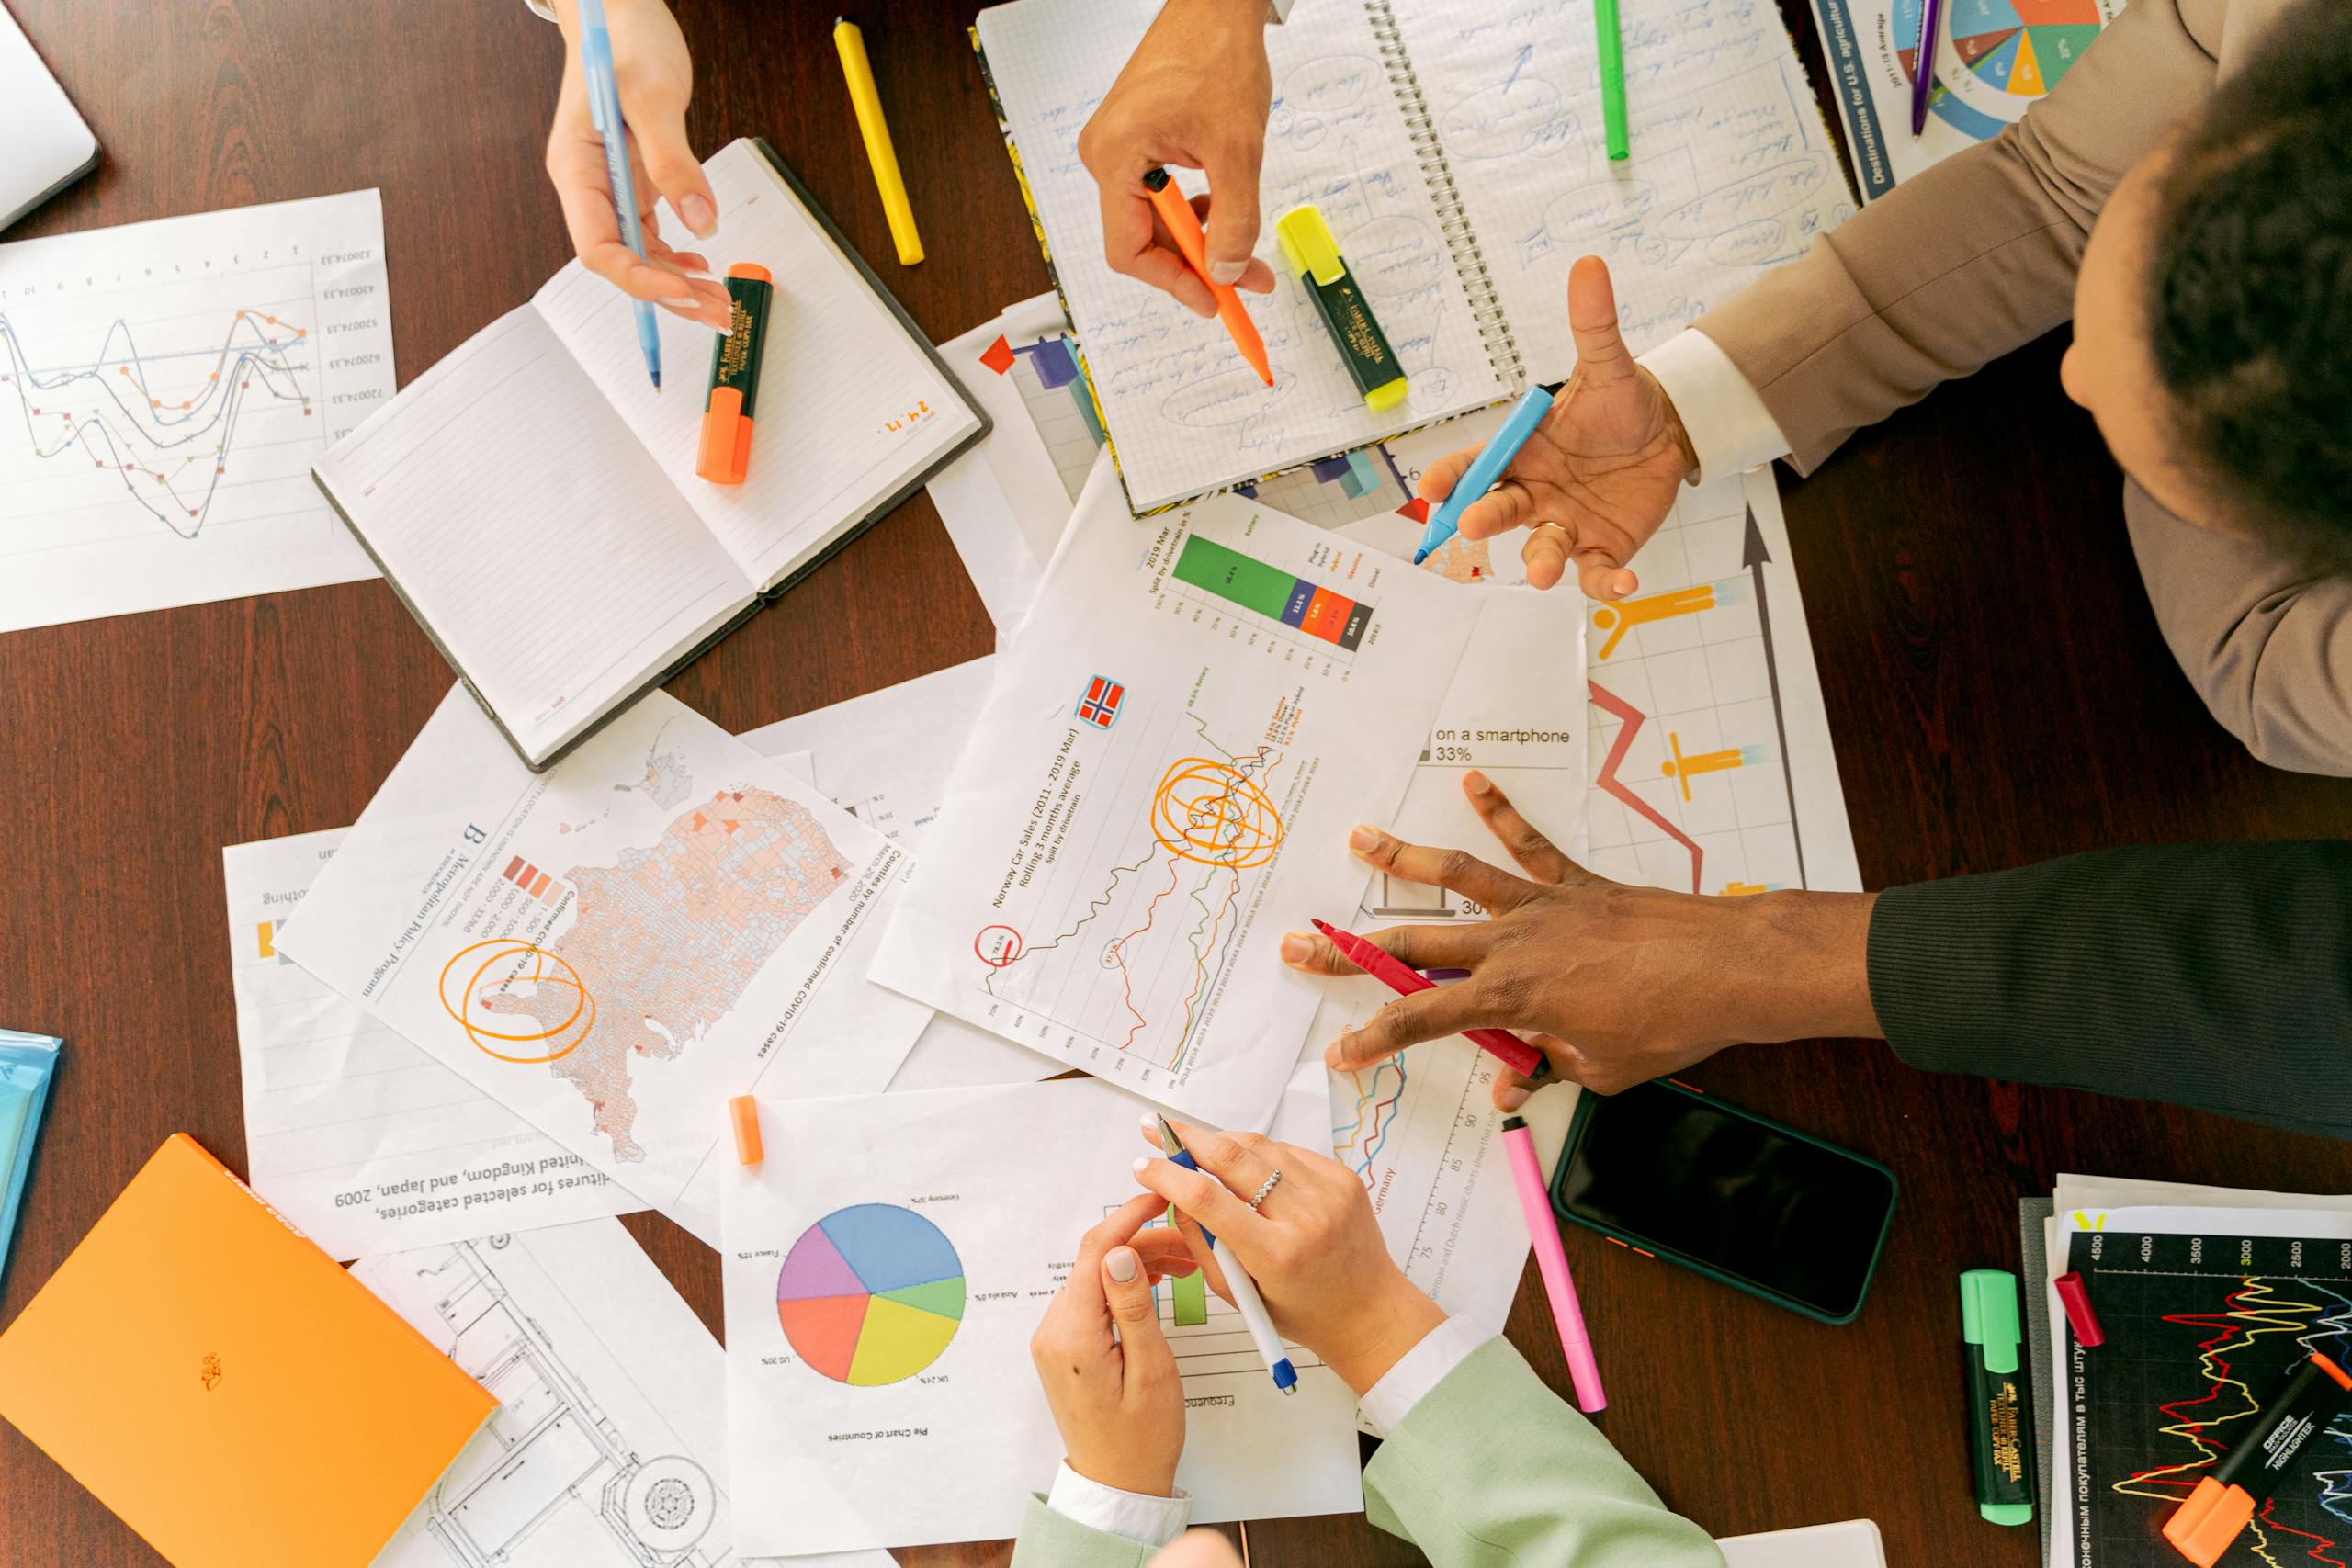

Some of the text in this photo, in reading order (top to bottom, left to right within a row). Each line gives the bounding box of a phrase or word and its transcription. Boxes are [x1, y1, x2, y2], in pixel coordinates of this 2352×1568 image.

[1872, 11, 1890, 51] Average
[1842, 60, 1859, 85] U.S.
[1851, 87, 1863, 105] for
[1856, 107, 1884, 185] Destinations
[1409, 467, 1420, 480] 6
[1179, 518, 1188, 527] in
[1146, 525, 1170, 569] 2019 Mar
[1160, 527, 1184, 565] drivetrain
[1157, 565, 1168, 577] by
[1345, 551, 1363, 580] Gasoline
[1367, 567, 1382, 588] Diesel
[1148, 576, 1162, 594] Split
[1436, 728, 1569, 744] on a smartphone
[1437, 747, 1471, 761] 33%
[511, 794, 538, 831] LOCATION
[991, 726, 1080, 908] Norway Car Sales (2011 2019 Mar)
[1017, 850, 1043, 888] Rolling
[1037, 800, 1064, 841] months
[1057, 759, 1082, 800] average
[1044, 793, 1082, 864] Split by drivetrain
[481, 835, 509, 873] UNKNOWN
[470, 870, 484, 886] ARE
[846, 841, 891, 903] March 29, 2020
[460, 886, 473, 902] NOT
[483, 876, 504, 903] 2,000
[359, 822, 487, 1002] B Metropolitan Policy Program
[516, 896, 533, 916] 500
[543, 887, 575, 932] Confirmed
[1462, 901, 1487, 914] 30
[479, 912, 501, 940] 2,000
[525, 915, 540, 934] 500
[754, 847, 901, 1062] Counties by number of confirmed COVID-19 cases
[499, 968, 519, 994] cases
[1478, 1070, 1491, 1085] 95
[1464, 1113, 1477, 1128] 90
[1477, 1127, 1491, 1146] that
[1450, 1157, 1463, 1171] 85
[1470, 1145, 1486, 1168] show
[429, 1173, 458, 1191] and
[461, 1158, 535, 1186] Kingdom,
[1462, 1168, 1479, 1194] charts
[334, 1189, 372, 1207] 2009
[375, 1176, 425, 1200] Japan,
[462, 1185, 527, 1209] selected
[530, 1180, 553, 1197] for
[1370, 1167, 1397, 1216] Germany
[374, 1194, 459, 1222] categories,
[1435, 1201, 1448, 1216] 80
[1453, 1196, 1470, 1223] music
[1444, 1222, 1462, 1247] Dutch
[1420, 1246, 1433, 1259] 75
[1439, 1247, 1453, 1266] and
[2092, 1235, 2102, 1260] 4500
[2142, 1235, 2152, 1262] 4000
[2191, 1237, 2202, 1264] 3500
[2241, 1239, 2251, 1265] 3000
[2291, 1241, 2302, 1267] 2500
[2340, 1242, 2351, 1269] 2000
[2074, 1377, 2084, 1400] тыс
[1183, 1395, 1234, 1409] Frequenc
[827, 1431, 872, 1442] Countries
[886, 1429, 910, 1438] Chart
[913, 1427, 927, 1436] Pie
[2261, 1412, 2295, 1452] OFFICE
[2271, 1418, 2315, 1472] HIGHLIGHTER
[2076, 1416, 2090, 1501] покупателям
[2079, 1506, 2091, 1567] онечным
